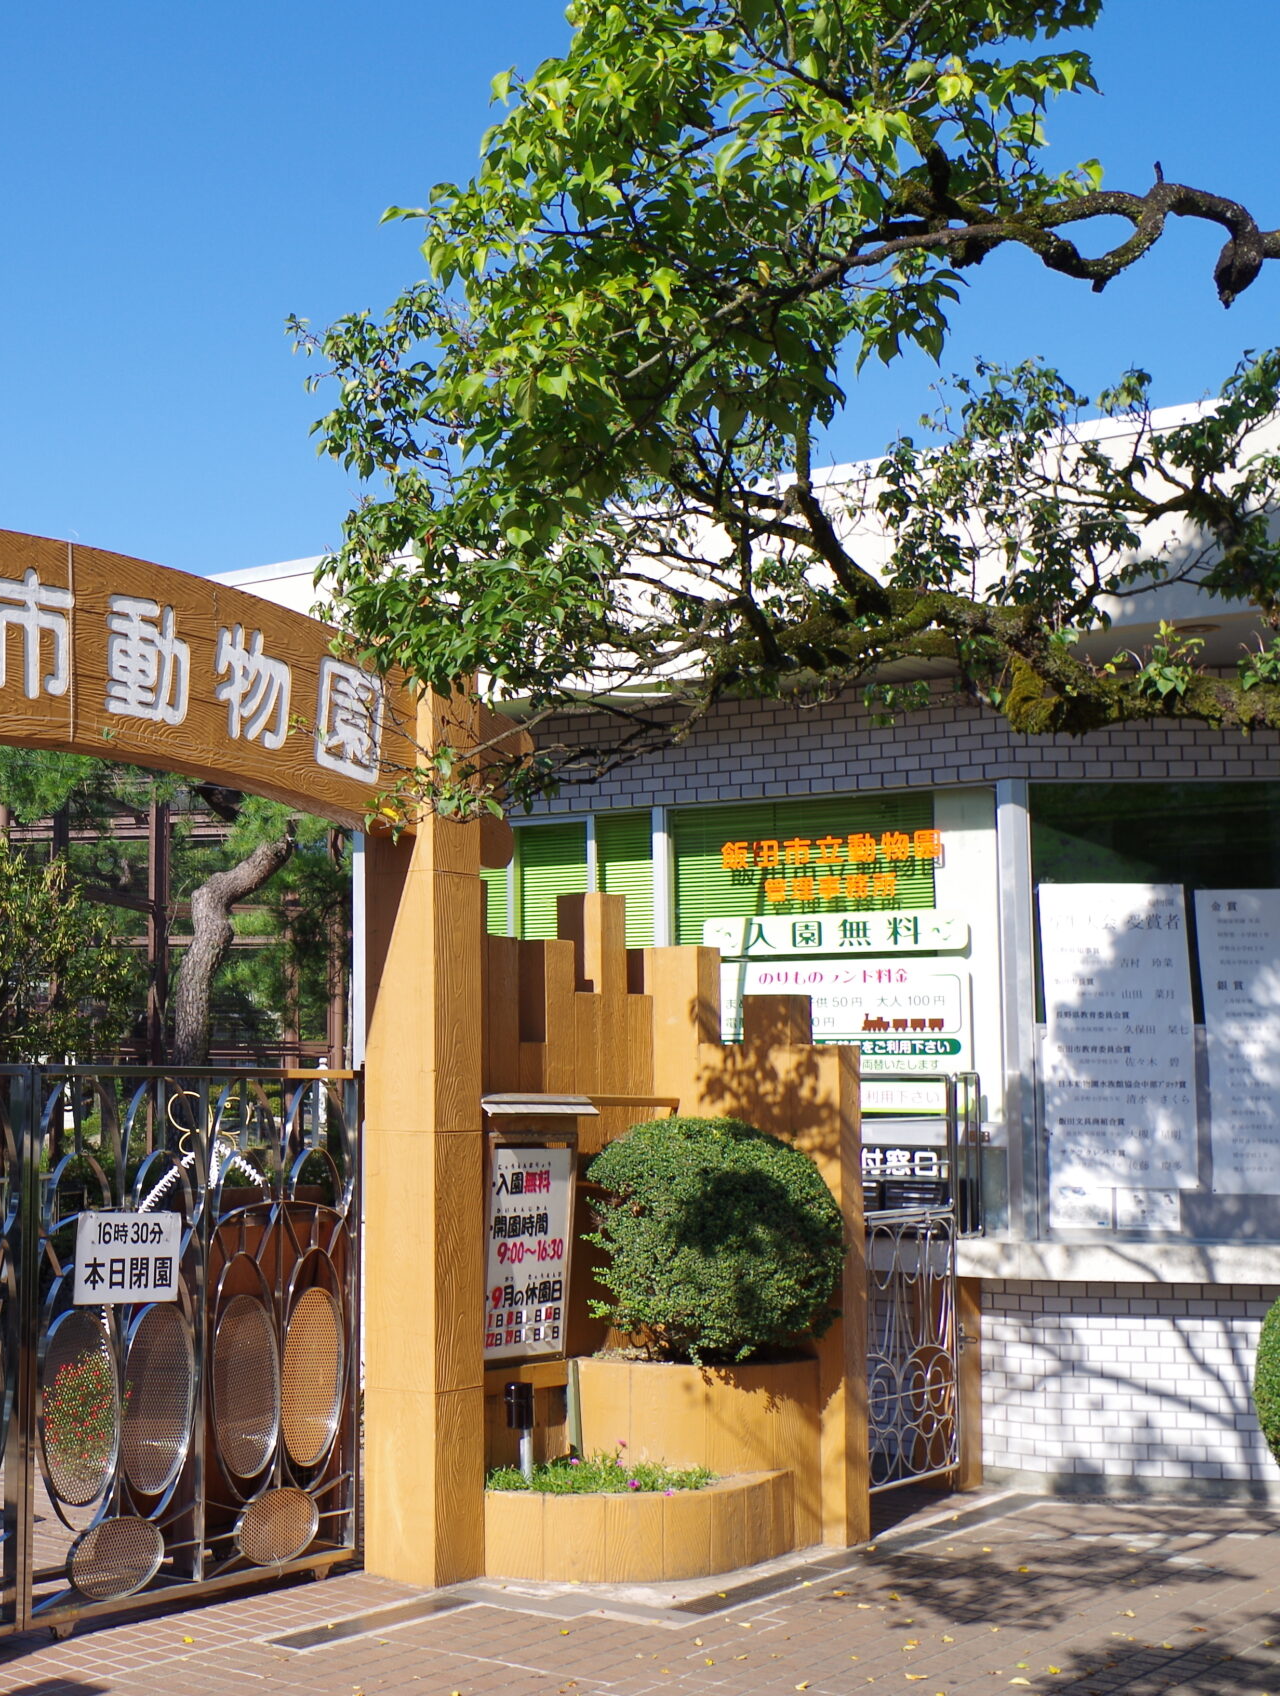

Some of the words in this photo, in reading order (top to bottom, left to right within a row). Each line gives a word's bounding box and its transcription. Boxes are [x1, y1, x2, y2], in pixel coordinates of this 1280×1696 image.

[721, 829, 941, 869] 飯田市立動物園
[764, 872, 896, 902] 管理事務所
[746, 916, 922, 949] 入園無料
[758, 968, 908, 985] のりものランド料金
[496, 1170, 551, 1196] 入園無料
[98, 1222, 163, 1245] 16時30分
[493, 1212, 549, 1240] 開園時間
[84, 1257, 172, 1290] 本日閉園
[491, 1280, 562, 1310] 9月の休園日
